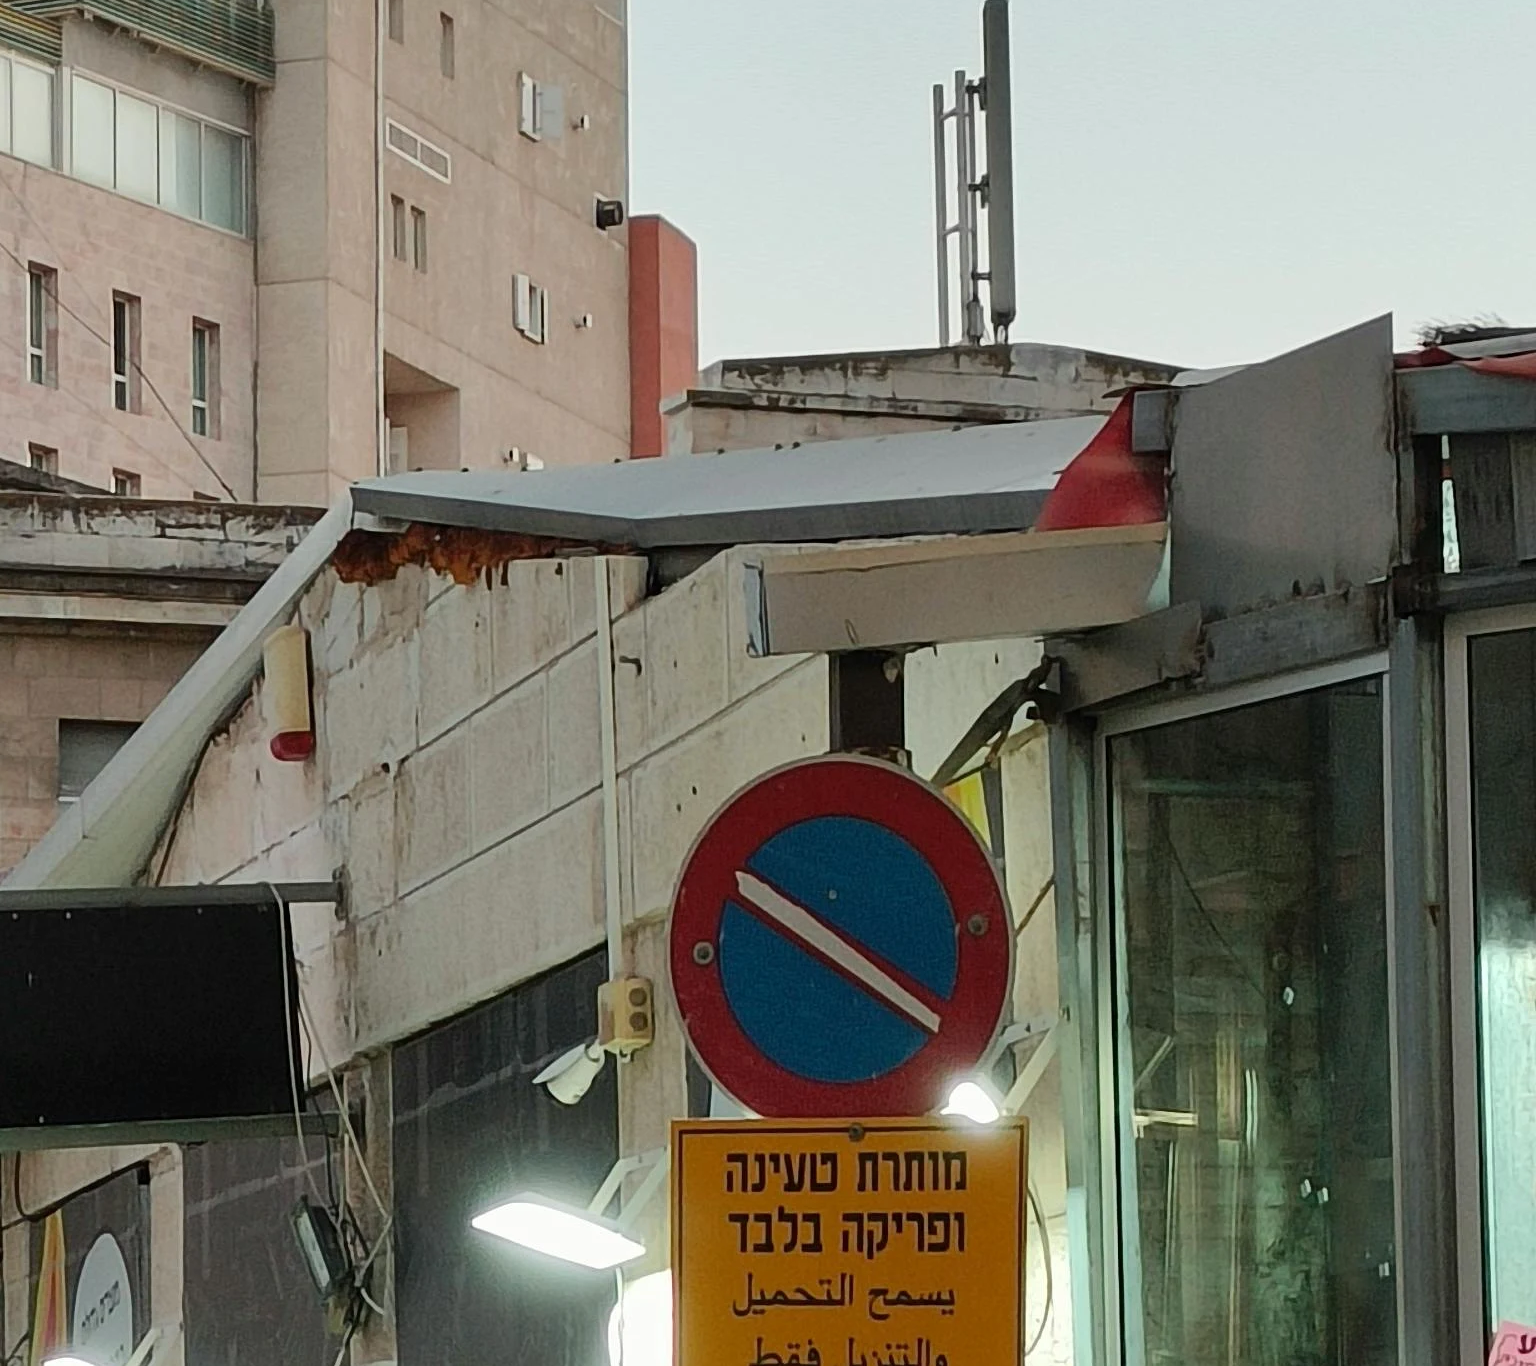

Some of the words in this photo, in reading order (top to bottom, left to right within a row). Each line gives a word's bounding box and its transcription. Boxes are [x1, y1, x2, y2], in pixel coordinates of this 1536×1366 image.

[725, 1152, 839, 1193] טעינה
[857, 1150, 968, 1192] מותרת
[727, 1205, 824, 1253] בלבד
[841, 1211, 966, 1260] ופריקה
[732, 1272, 855, 1317] التحميل
[867, 1287, 956, 1321] يسمح
